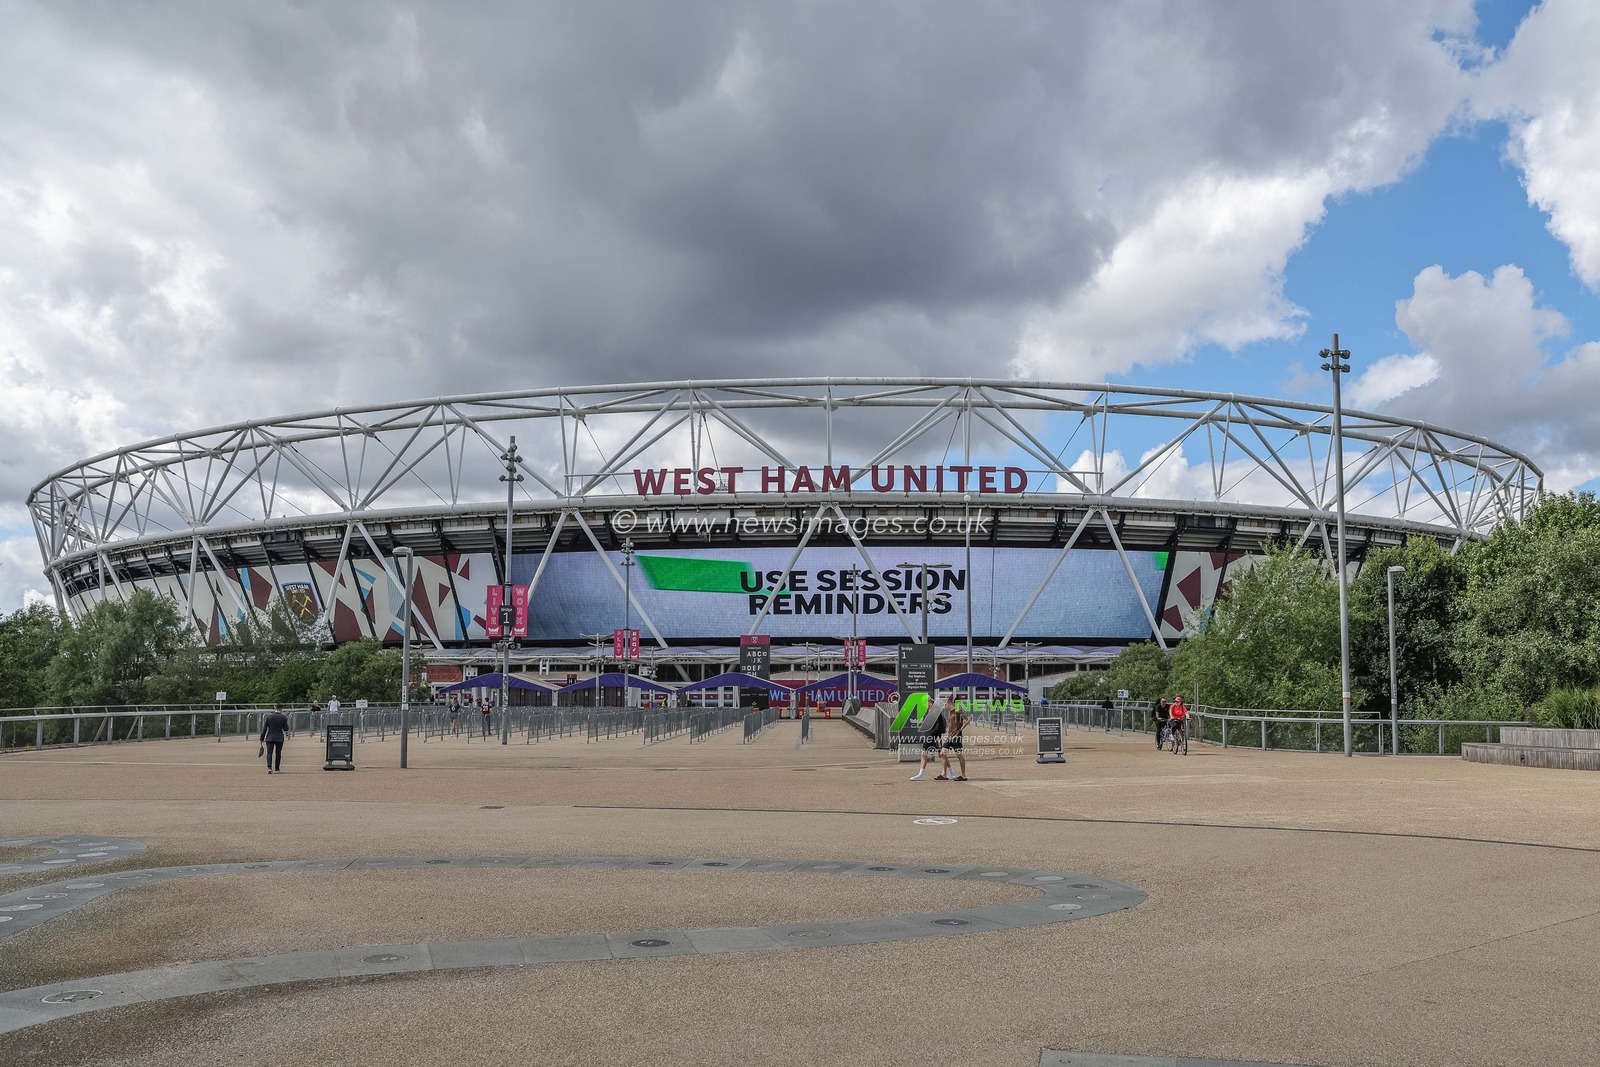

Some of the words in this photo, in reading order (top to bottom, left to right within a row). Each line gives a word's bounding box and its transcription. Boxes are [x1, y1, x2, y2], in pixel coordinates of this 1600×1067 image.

[633, 467, 743, 495] WEST
[761, 465, 850, 493] HAM
[871, 465, 1028, 493] UNITED
[740, 570, 808, 592] USE
[816, 569, 965, 592] SESSION
[490, 588, 498, 625] LIVE
[515, 588, 525, 625] WORK
[749, 593, 952, 615] REMINDERS
[503, 612, 510, 624] 1
[901, 651, 907, 659] 1
